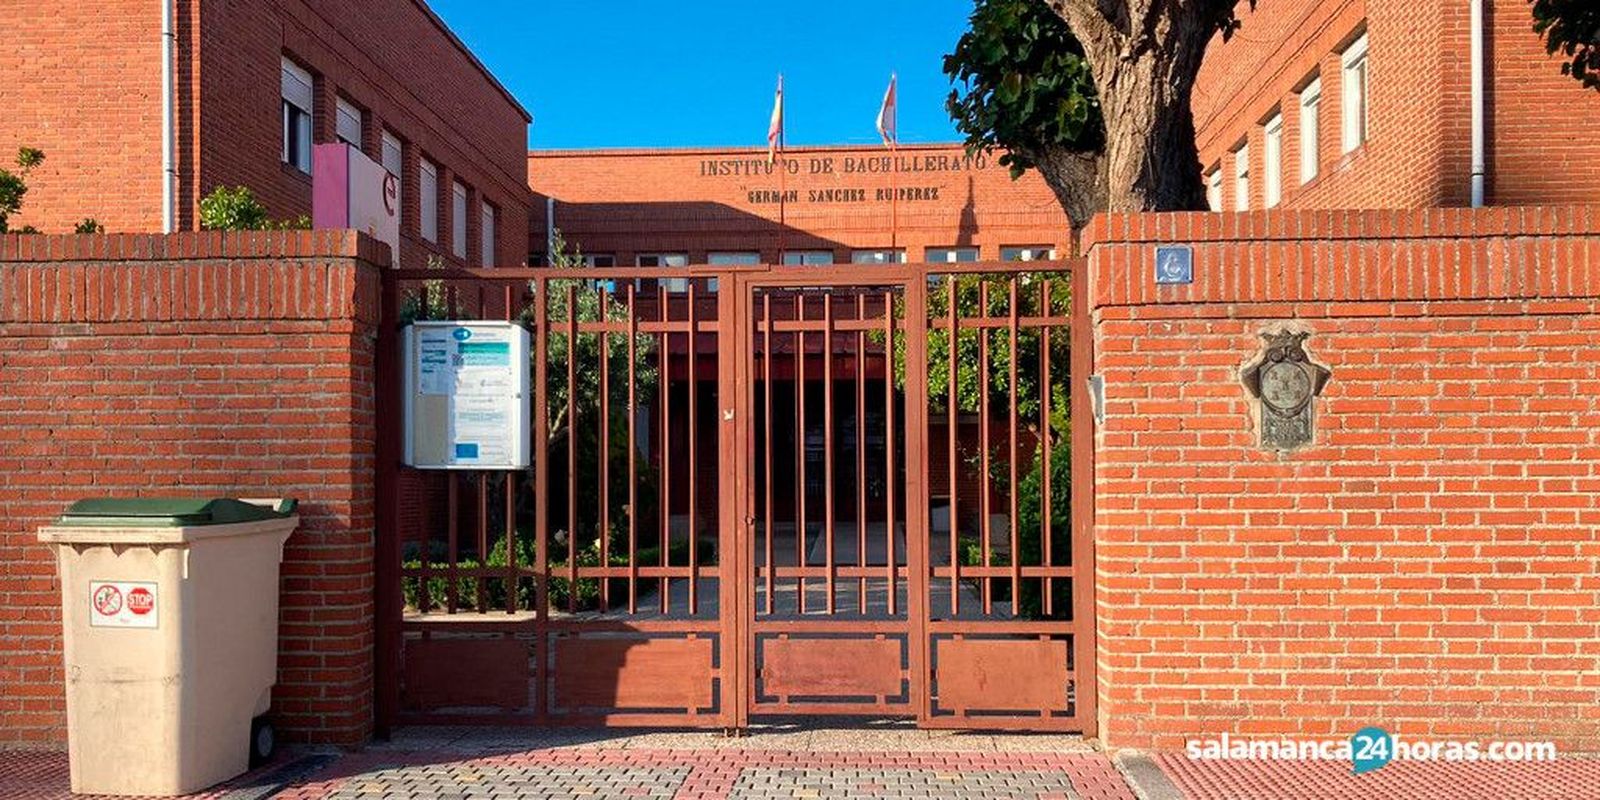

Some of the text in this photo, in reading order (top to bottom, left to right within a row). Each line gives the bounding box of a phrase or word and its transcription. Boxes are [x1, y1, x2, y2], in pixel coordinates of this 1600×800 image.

[810, 157, 833, 174] DE
[844, 155, 986, 173] BACHILLERATO
[808, 188, 866, 202] SANCHEZ
[128, 593, 153, 605] STOP
